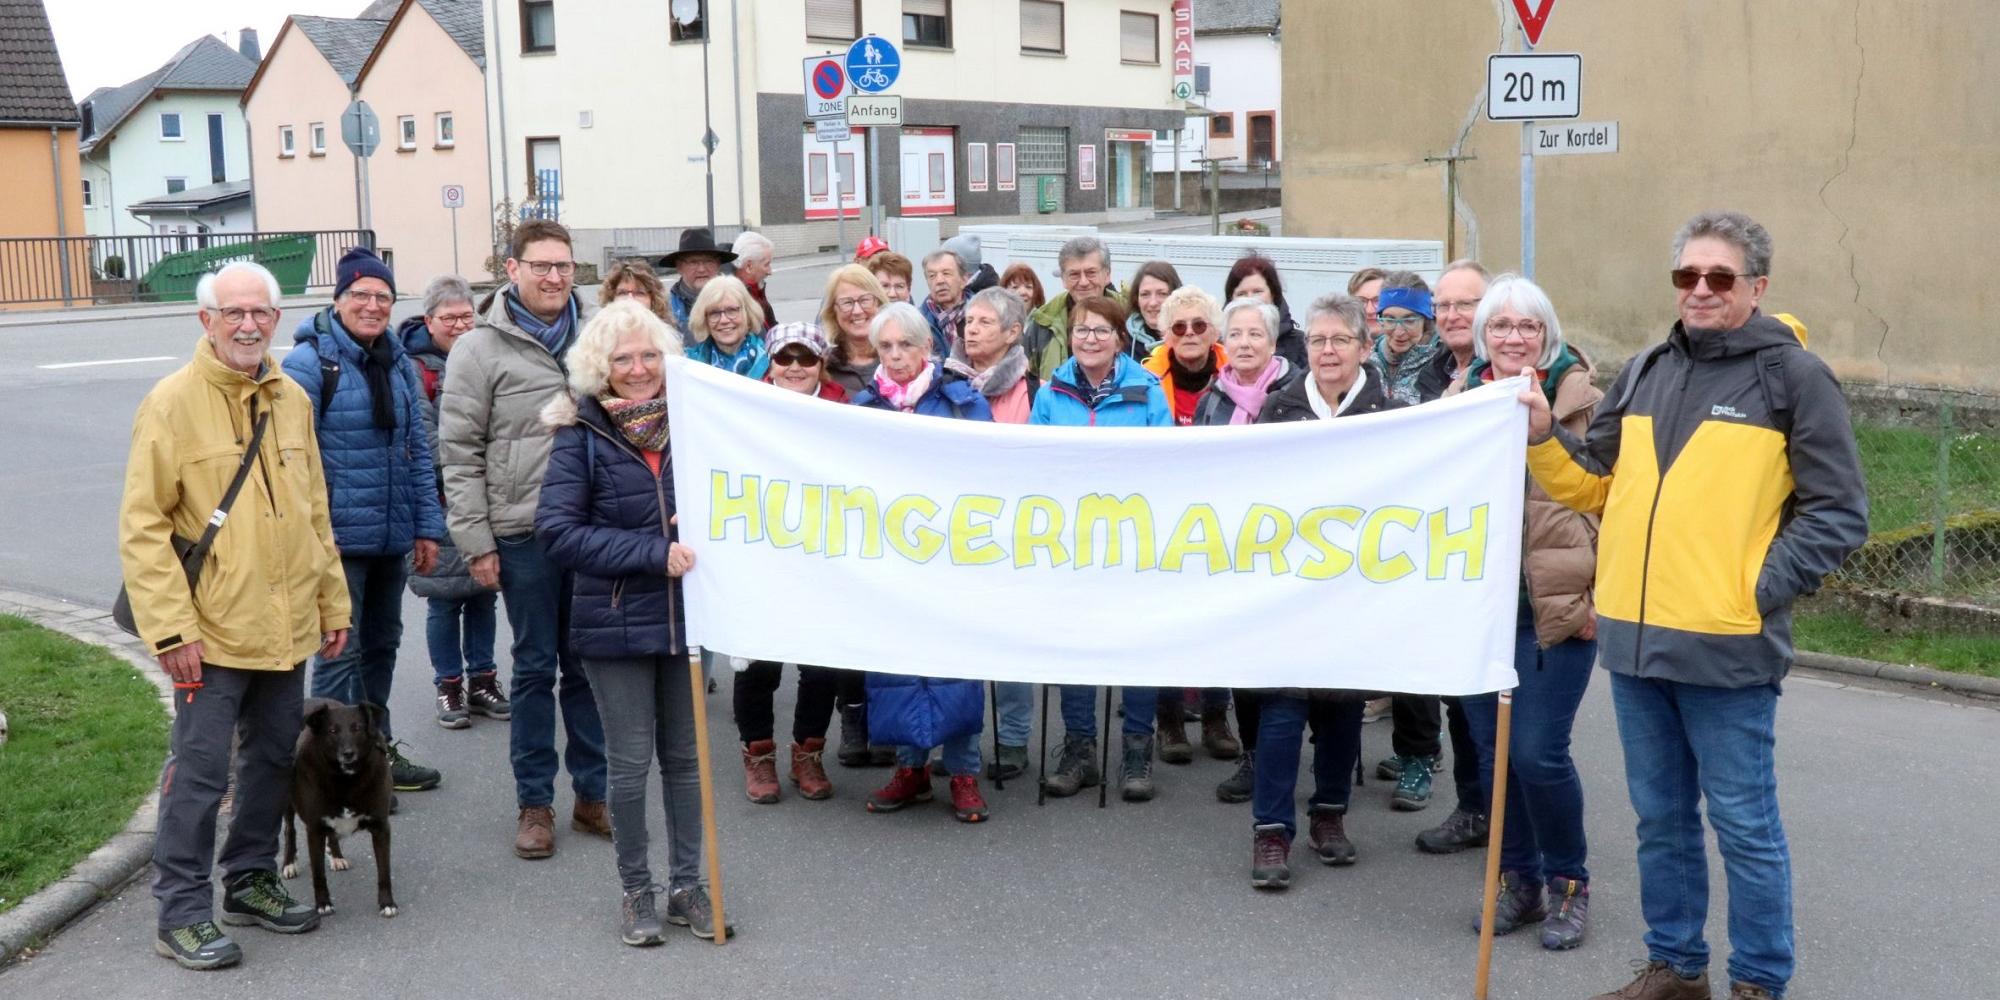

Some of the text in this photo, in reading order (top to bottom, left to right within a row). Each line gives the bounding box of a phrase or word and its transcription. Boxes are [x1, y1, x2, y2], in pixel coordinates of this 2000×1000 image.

[1175, 8, 1191, 71] SPAR
[1503, 72, 1565, 102] 20 m
[819, 101, 843, 113] ZONE
[851, 105, 897, 118] Anfang
[1539, 127, 1608, 148] Zur Kordel
[709, 469, 1490, 583] HUNGERMARSCH
